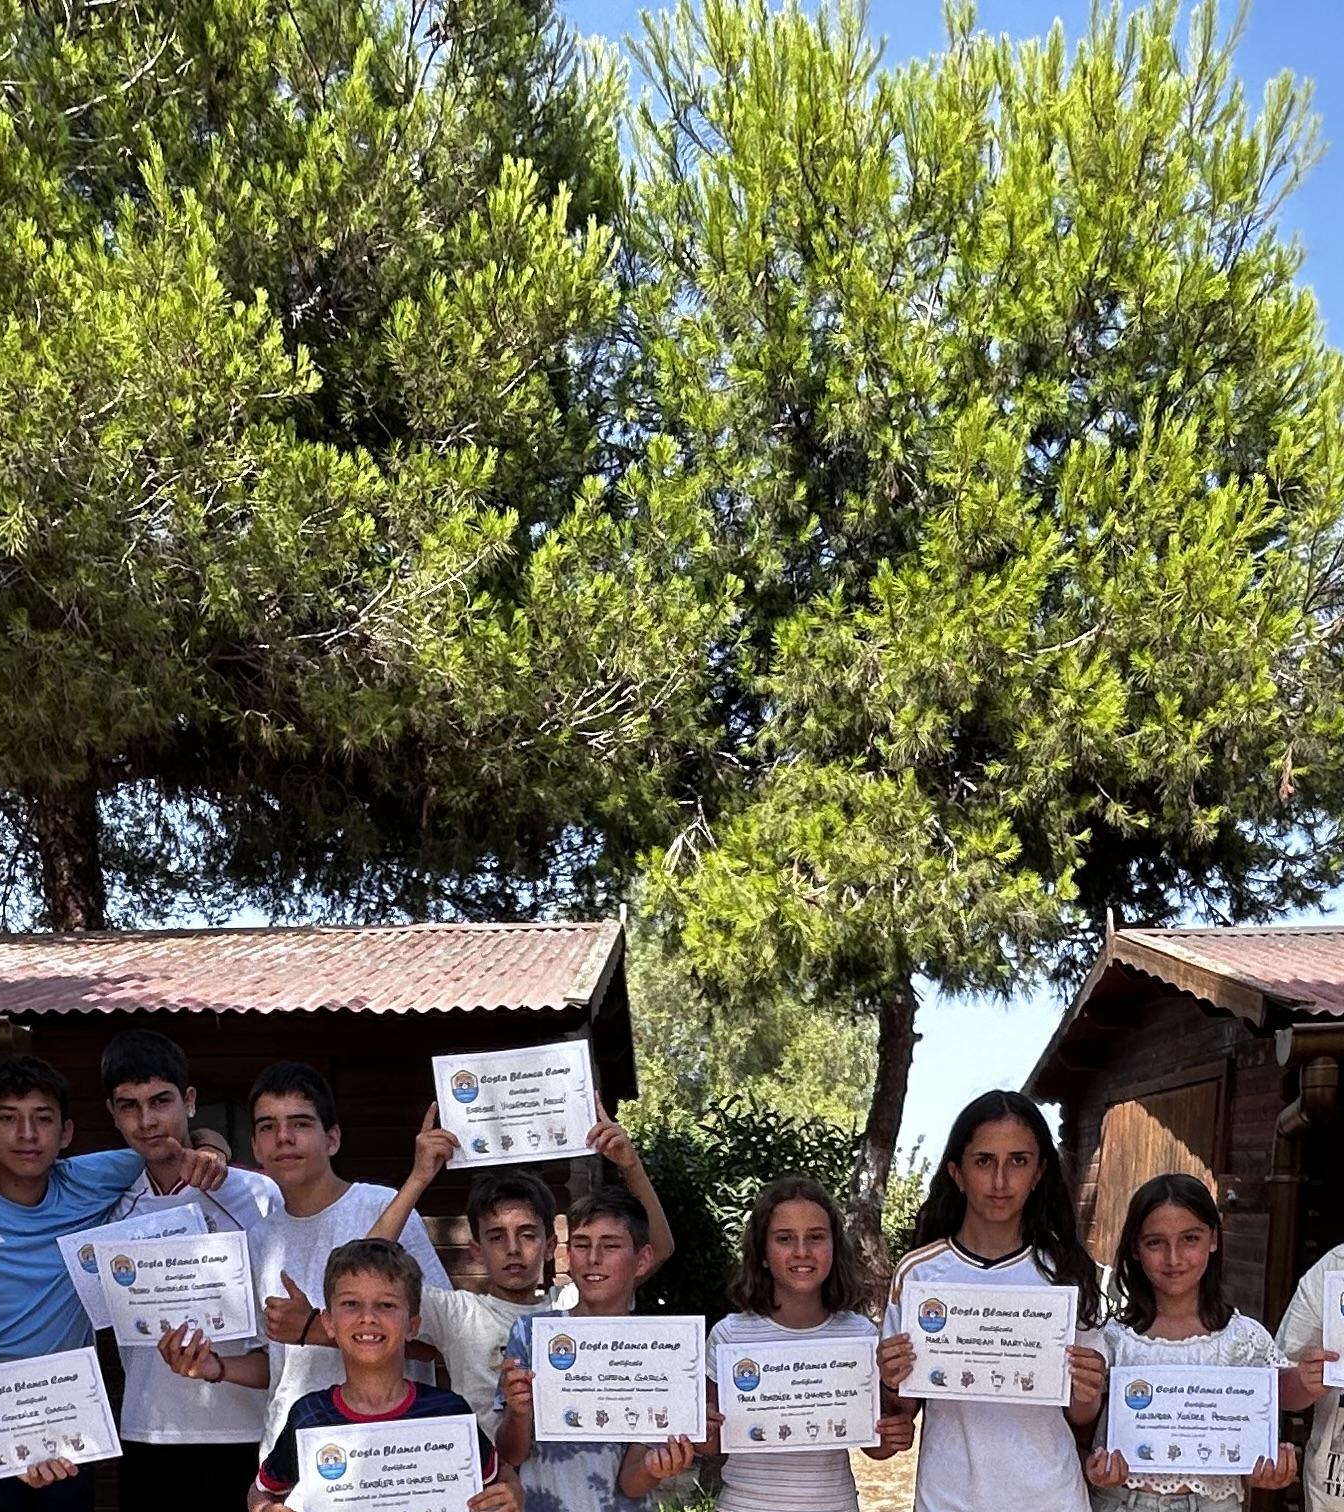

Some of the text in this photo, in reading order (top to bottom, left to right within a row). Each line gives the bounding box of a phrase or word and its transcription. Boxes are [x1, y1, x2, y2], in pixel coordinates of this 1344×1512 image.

[480, 1067, 570, 1084] Costa Blanca Camp
[162, 1227, 187, 1237] Camp
[137, 1255, 228, 1269] Costa Blanca Camp
[950, 1306, 1052, 1320] Costa Blanca Camp
[579, 1341, 681, 1350] Costa Blanca Camp
[763, 1360, 857, 1372] Costa Blanca Camp
[14, 1379, 49, 1393] Blanca
[51, 1374, 78, 1385] Camp
[1187, 1386, 1223, 1395] Blanca
[1225, 1386, 1255, 1396] Camp
[349, 1442, 454, 1458] Costa Blanca Camp
